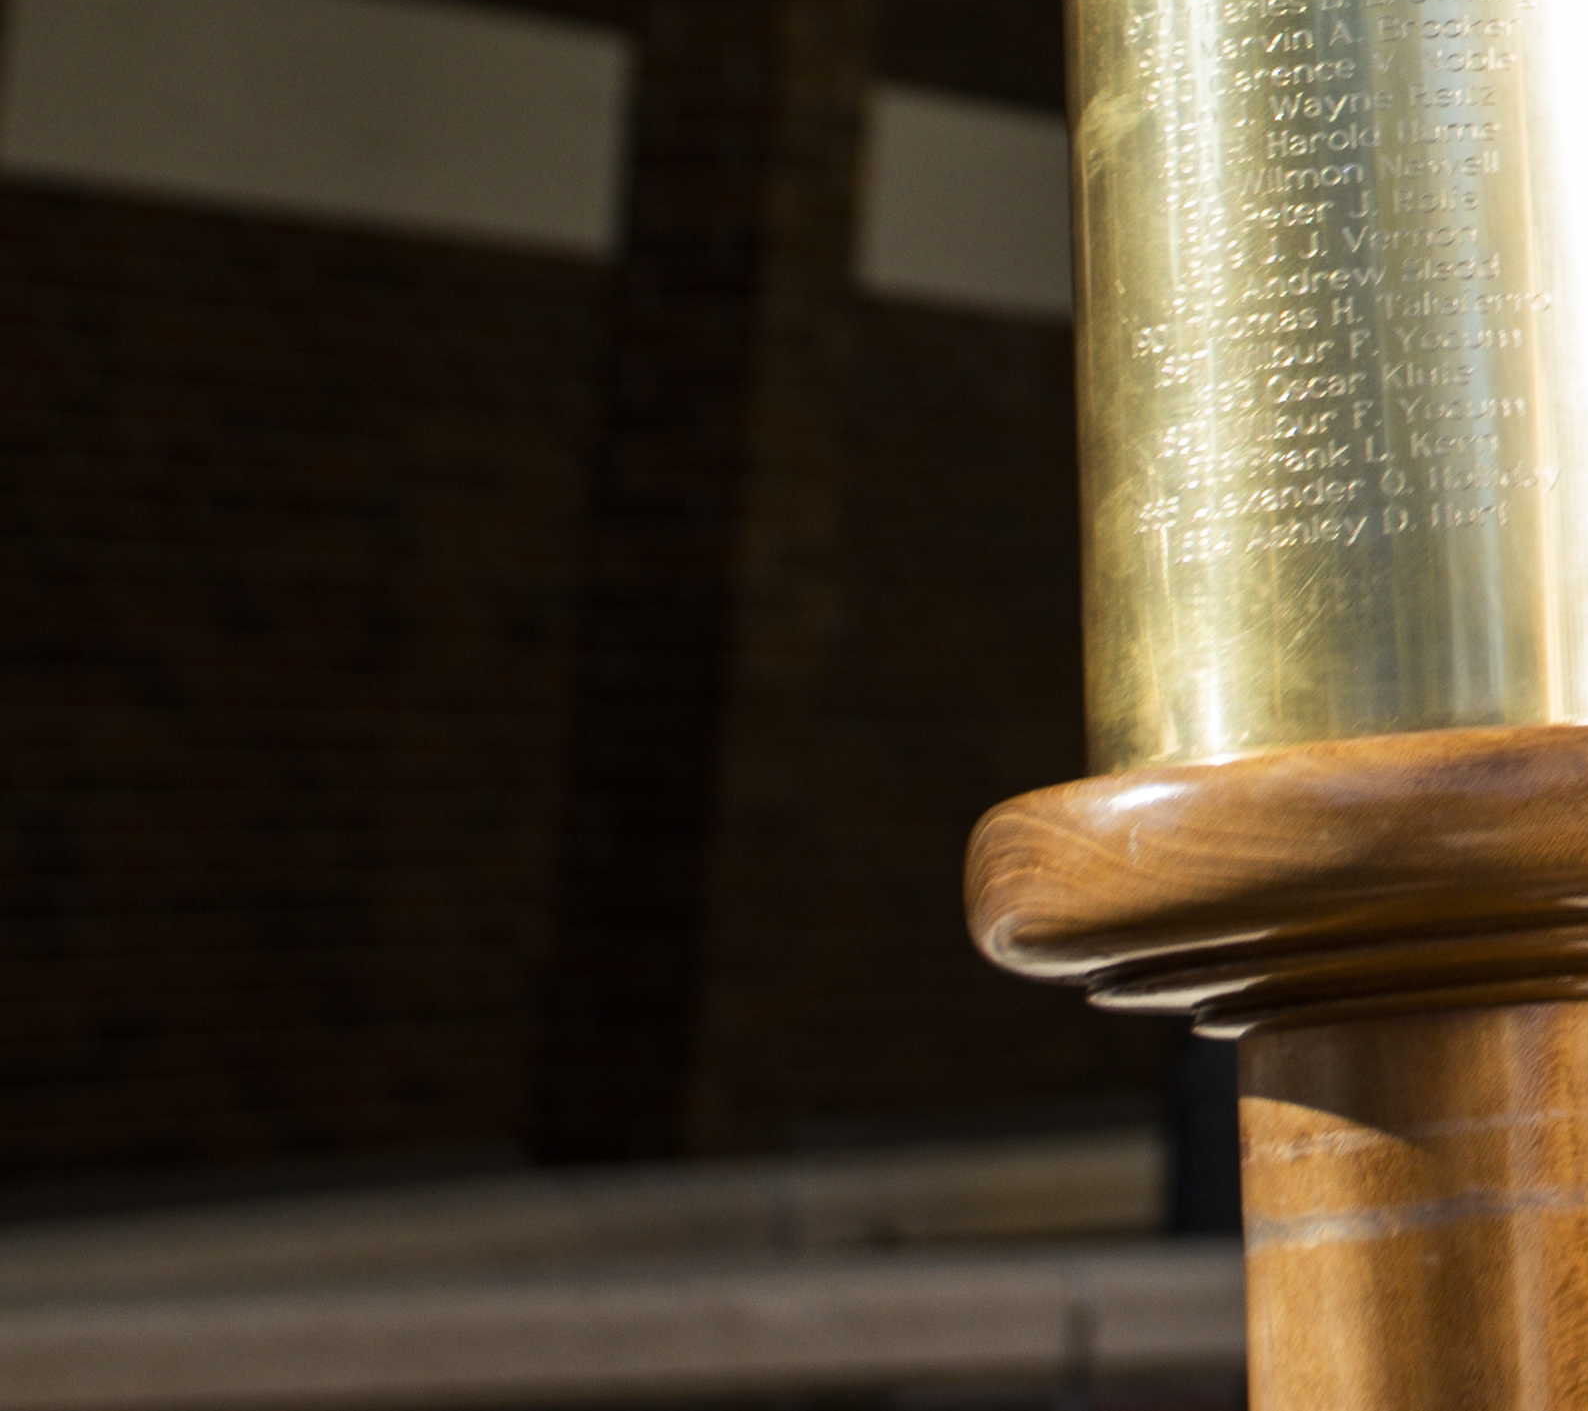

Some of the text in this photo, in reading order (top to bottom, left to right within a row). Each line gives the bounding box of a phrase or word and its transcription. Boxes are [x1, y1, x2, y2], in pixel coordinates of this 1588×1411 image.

[1328, 19, 1363, 47] A.
[1268, 89, 1394, 123] Wayne
[1408, 81, 1498, 108] Reitz
[1265, 121, 1381, 160] Harold
[1378, 149, 1500, 178] Newell
[1341, 225, 1479, 254] Vernon
[1240, 265, 1387, 302] Andrew
[1330, 296, 1364, 327] H.
[1266, 371, 1367, 404] Oscar
[1364, 435, 1396, 464] L.
